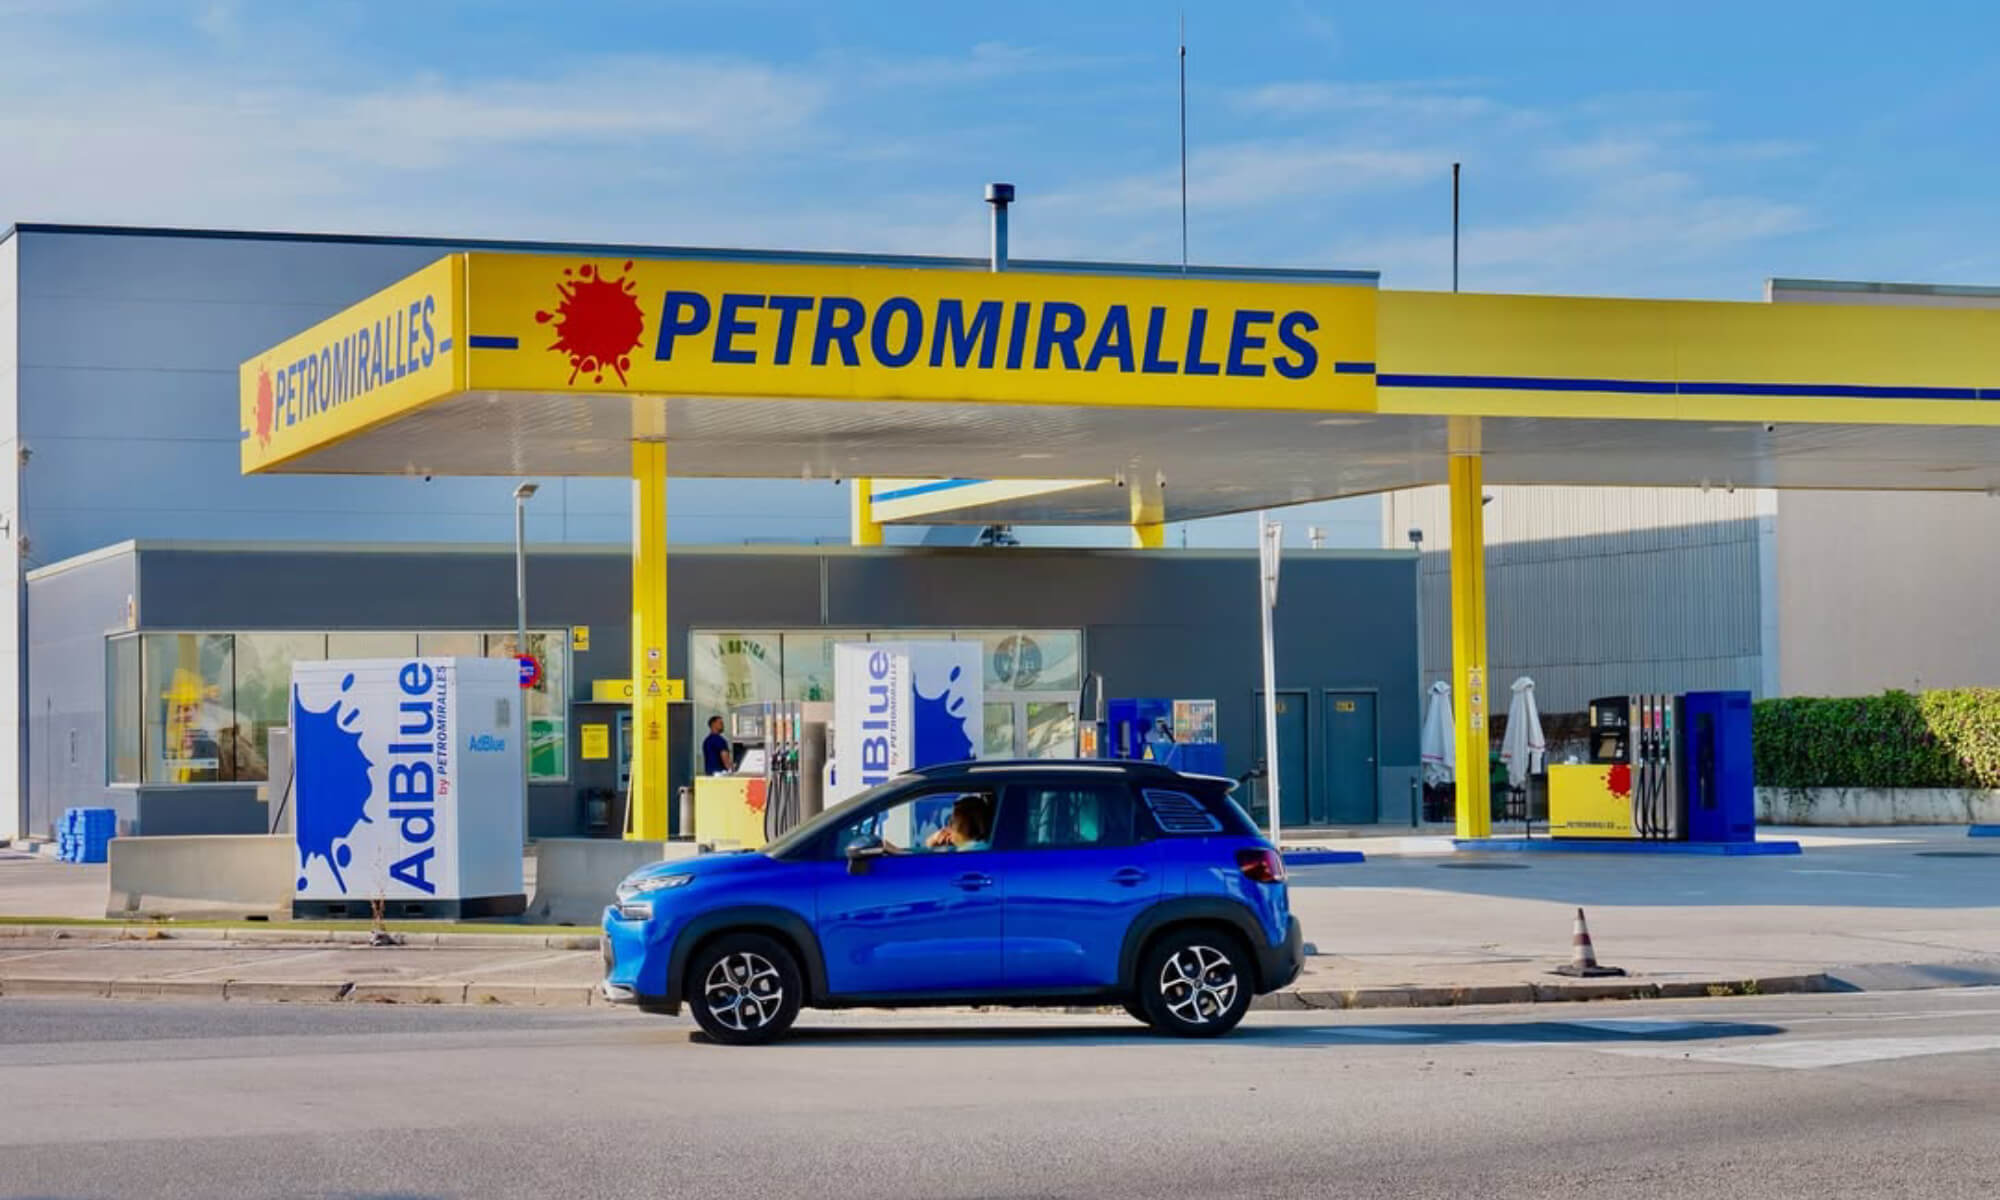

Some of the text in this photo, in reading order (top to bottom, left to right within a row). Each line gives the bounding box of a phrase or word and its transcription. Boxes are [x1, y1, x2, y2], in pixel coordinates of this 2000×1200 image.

[275, 294, 434, 432] PETROMIRALLES
[655, 290, 1319, 379] PETROMIRALLES
[388, 662, 436, 895] AdBlue
[436, 665, 451, 796] by PETROMIRALLES
[469, 734, 506, 752] AdBlue
